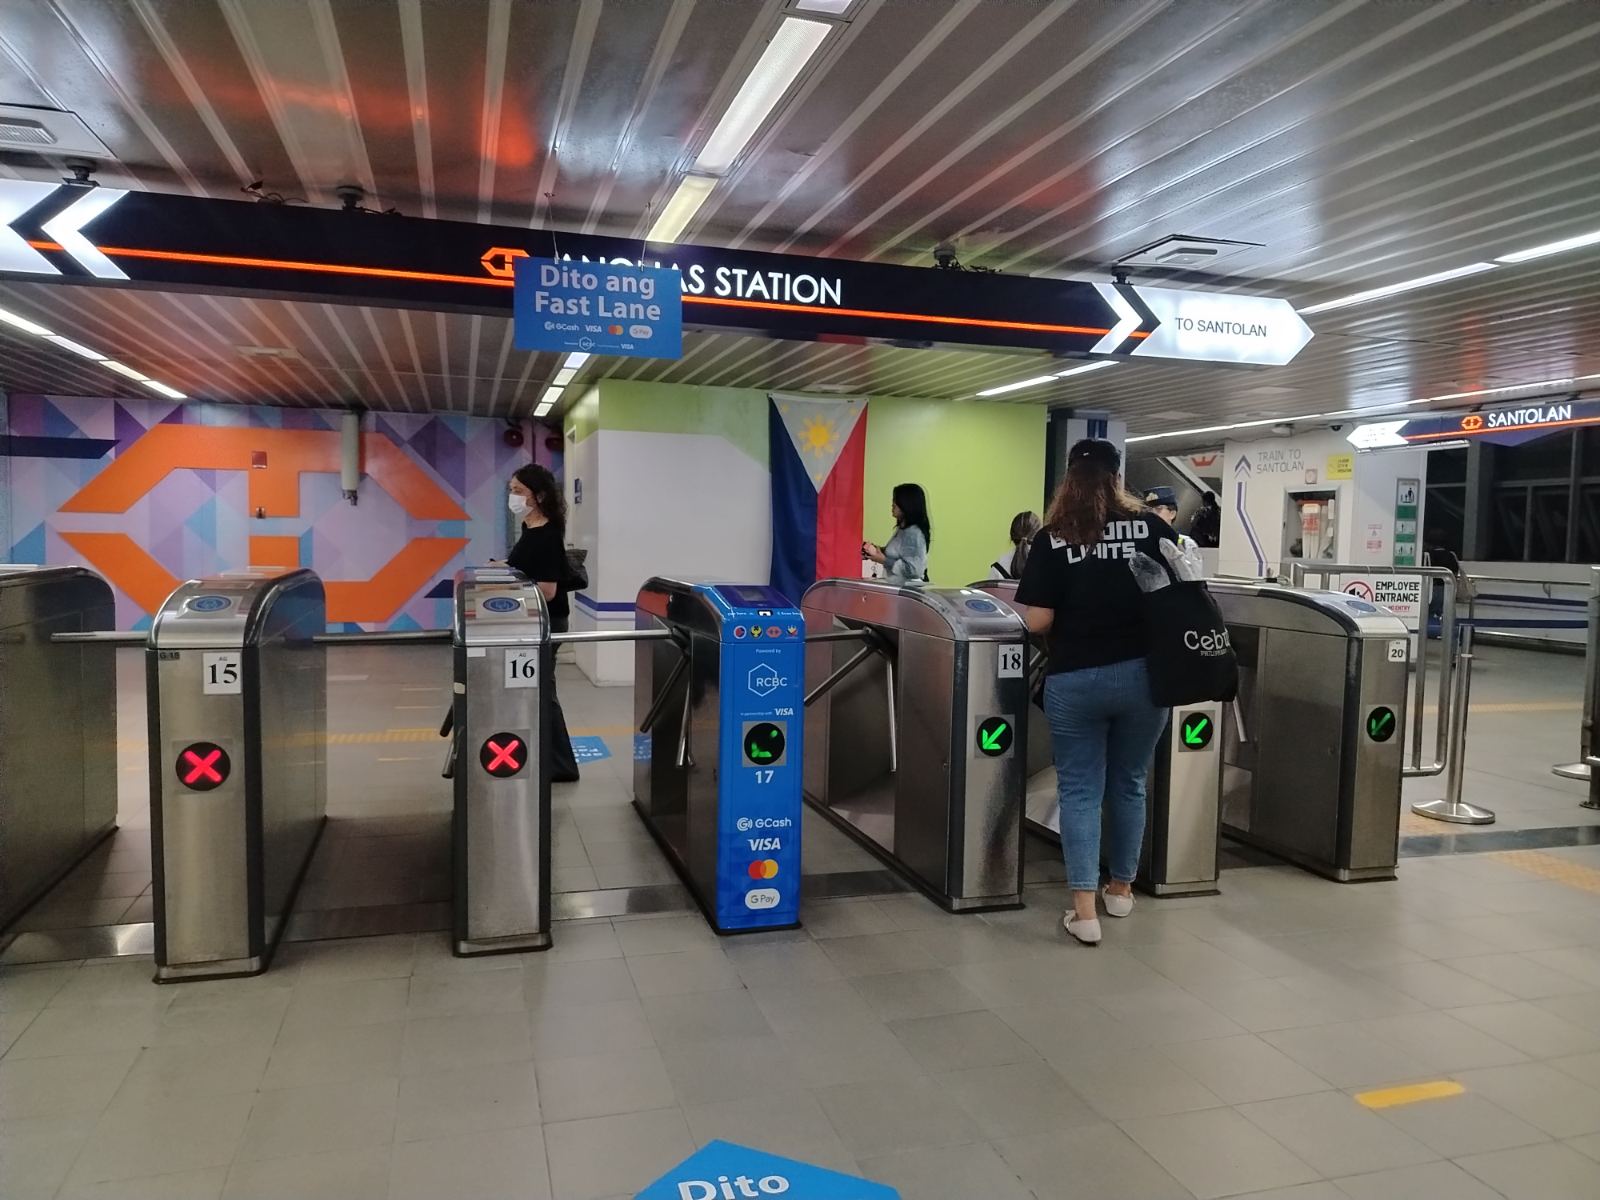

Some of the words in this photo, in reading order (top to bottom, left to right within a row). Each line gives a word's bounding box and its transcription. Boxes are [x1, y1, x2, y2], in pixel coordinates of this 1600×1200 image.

[540, 264, 598, 290] Dito
[606, 275, 655, 300] ang
[714, 266, 842, 306] STATION
[535, 291, 591, 316] Fast
[598, 296, 661, 321] Lane
[585, 325, 602, 334] VISA
[1175, 317, 1194, 331] TO
[1197, 320, 1267, 337] SANTOLAN
[1487, 405, 1572, 428] SANTOLAN
[1258, 450, 1283, 462] TRAIN
[1289, 448, 1302, 460] TO
[1256, 462, 1304, 475] SANTOLAN
[1375, 581, 1420, 591] EMPLOYEE
[1375, 592, 1419, 603] ENTRANCE
[1391, 648, 1404, 658] 20
[1002, 652, 1021, 670] 18
[208, 663, 238, 684] 15
[509, 659, 535, 678] 16
[756, 677, 787, 687] RCBC
[774, 707, 794, 716] VISA
[755, 770, 774, 784] 17
[755, 817, 792, 828] GCash
[748, 837, 781, 851] VISA
[760, 894, 776, 905] Pay
[677, 1175, 790, 1200] Dito
